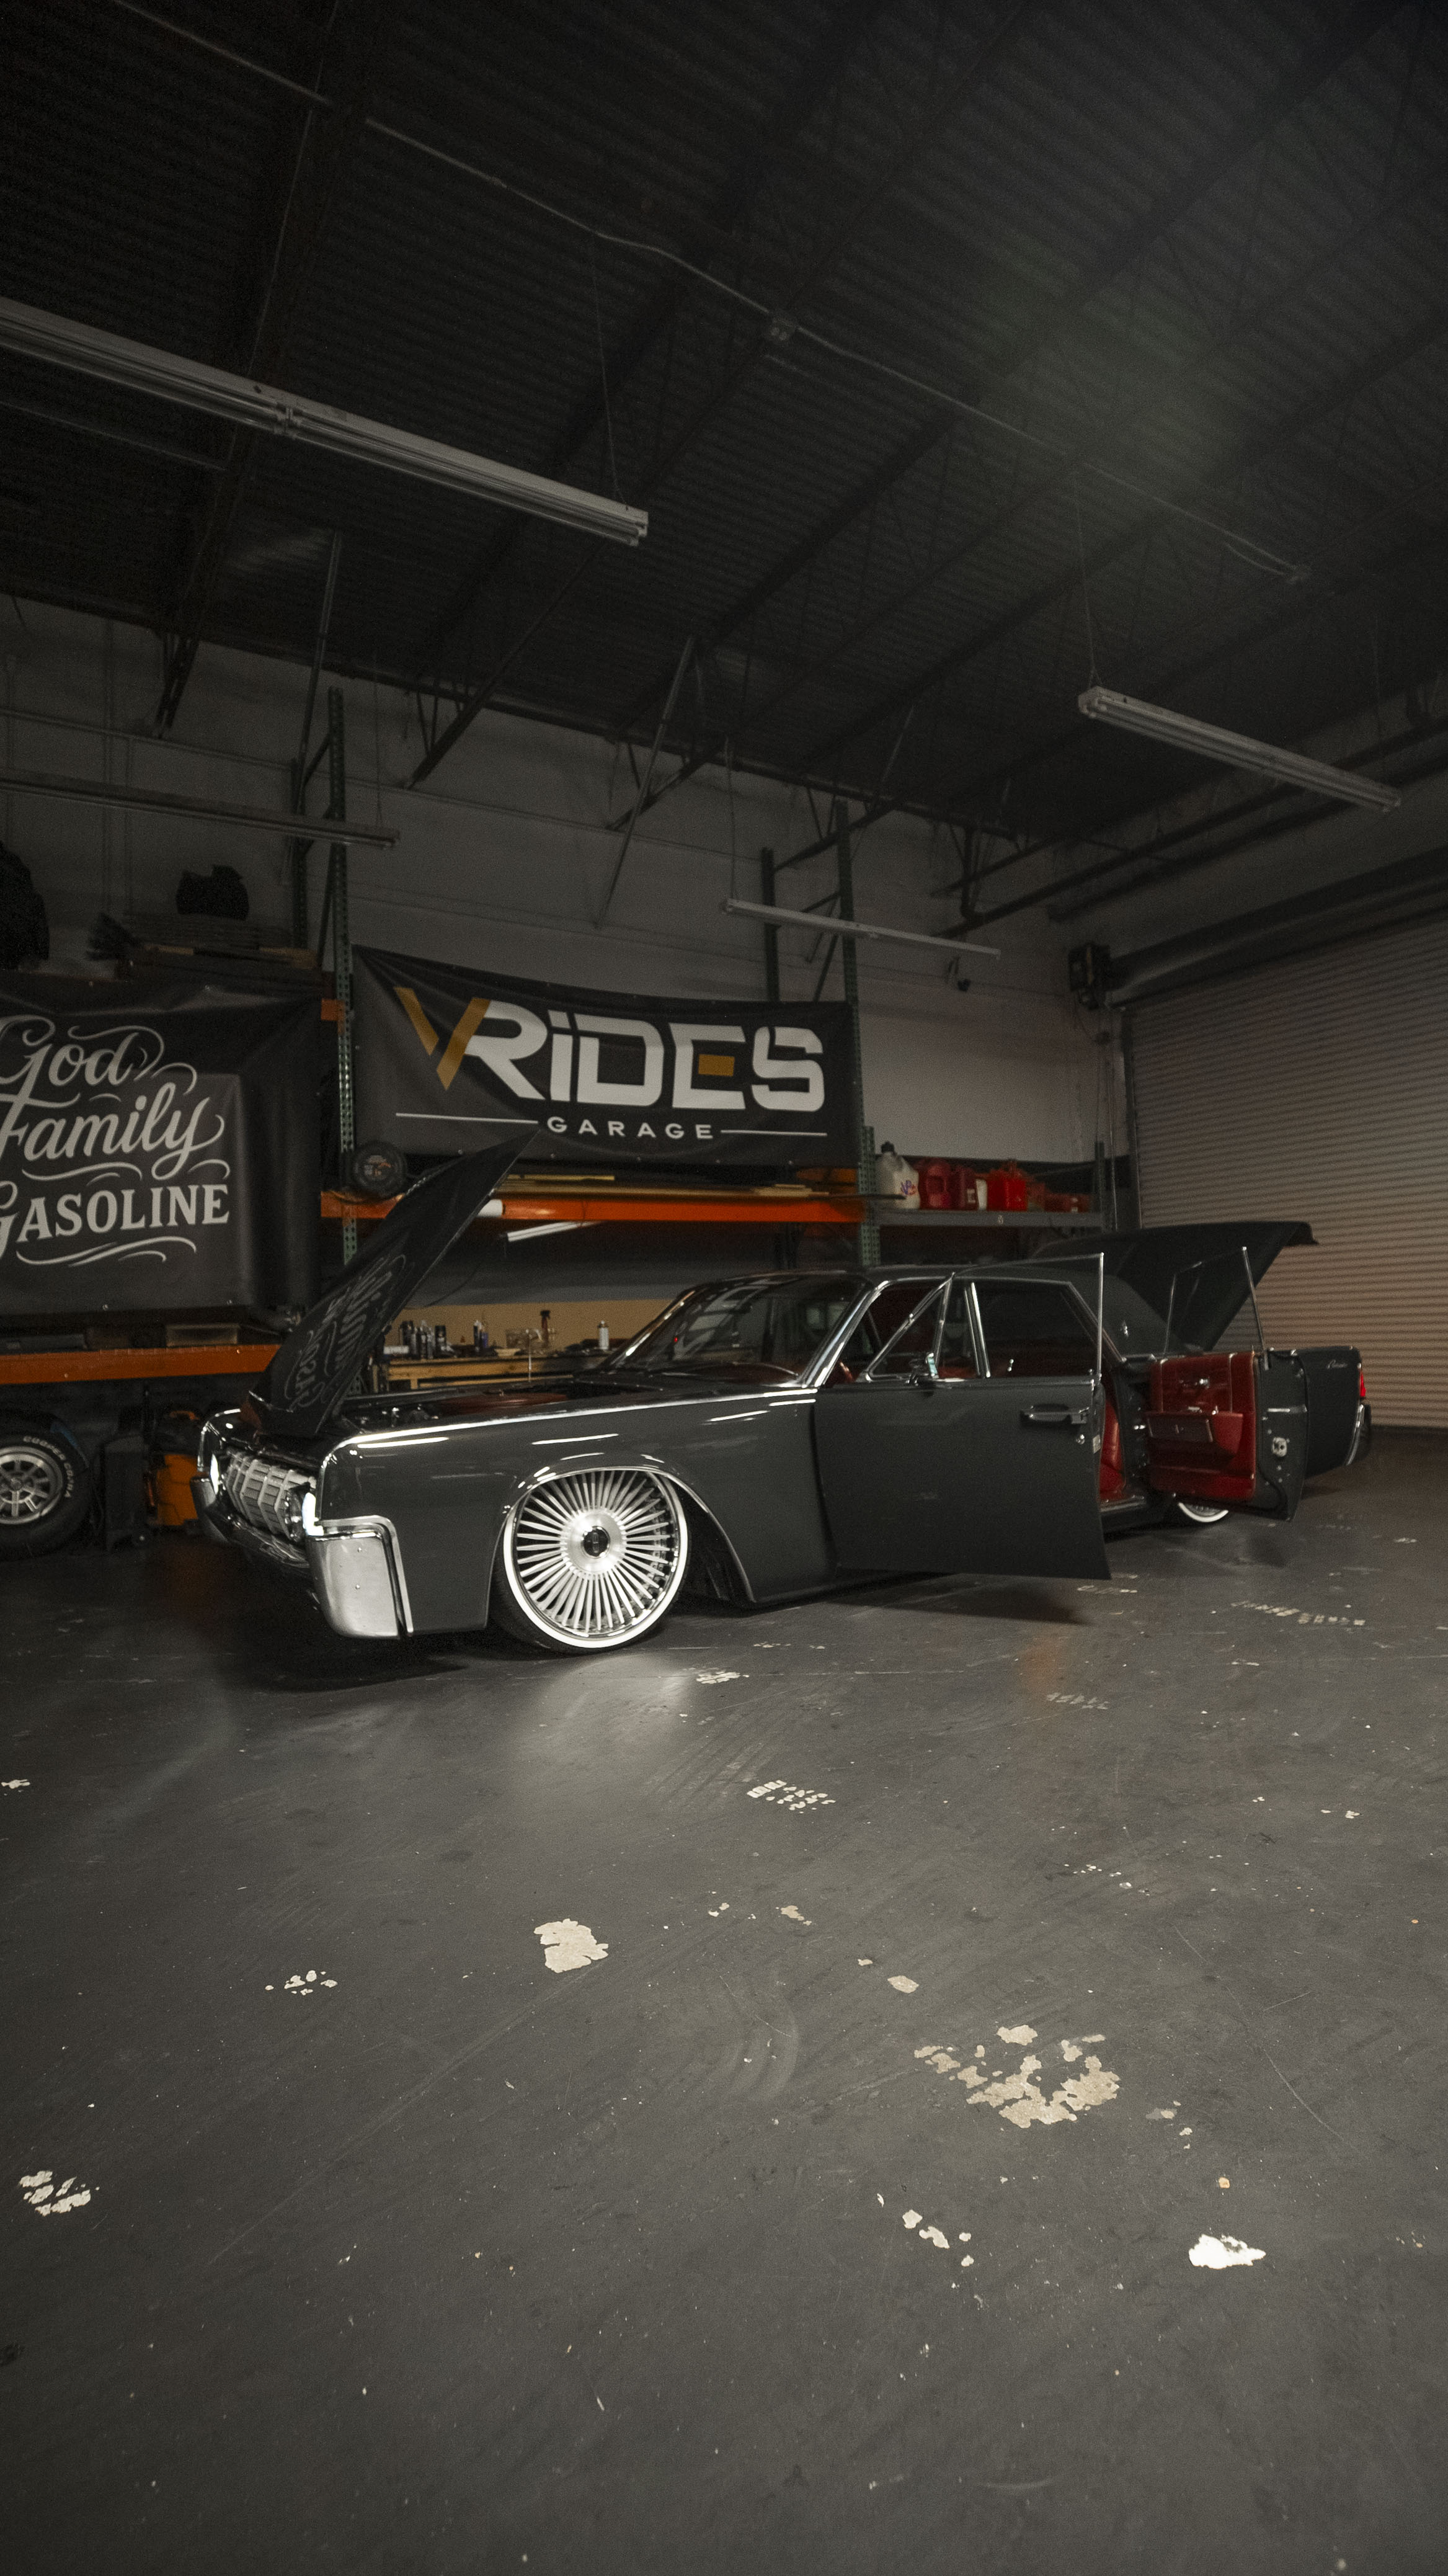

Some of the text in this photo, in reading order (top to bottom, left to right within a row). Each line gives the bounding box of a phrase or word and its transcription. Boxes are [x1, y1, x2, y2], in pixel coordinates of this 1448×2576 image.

[0, 1015, 143, 1086] God
[0, 1082, 224, 1180] Family
[547, 1116, 714, 1139] GARAGE
